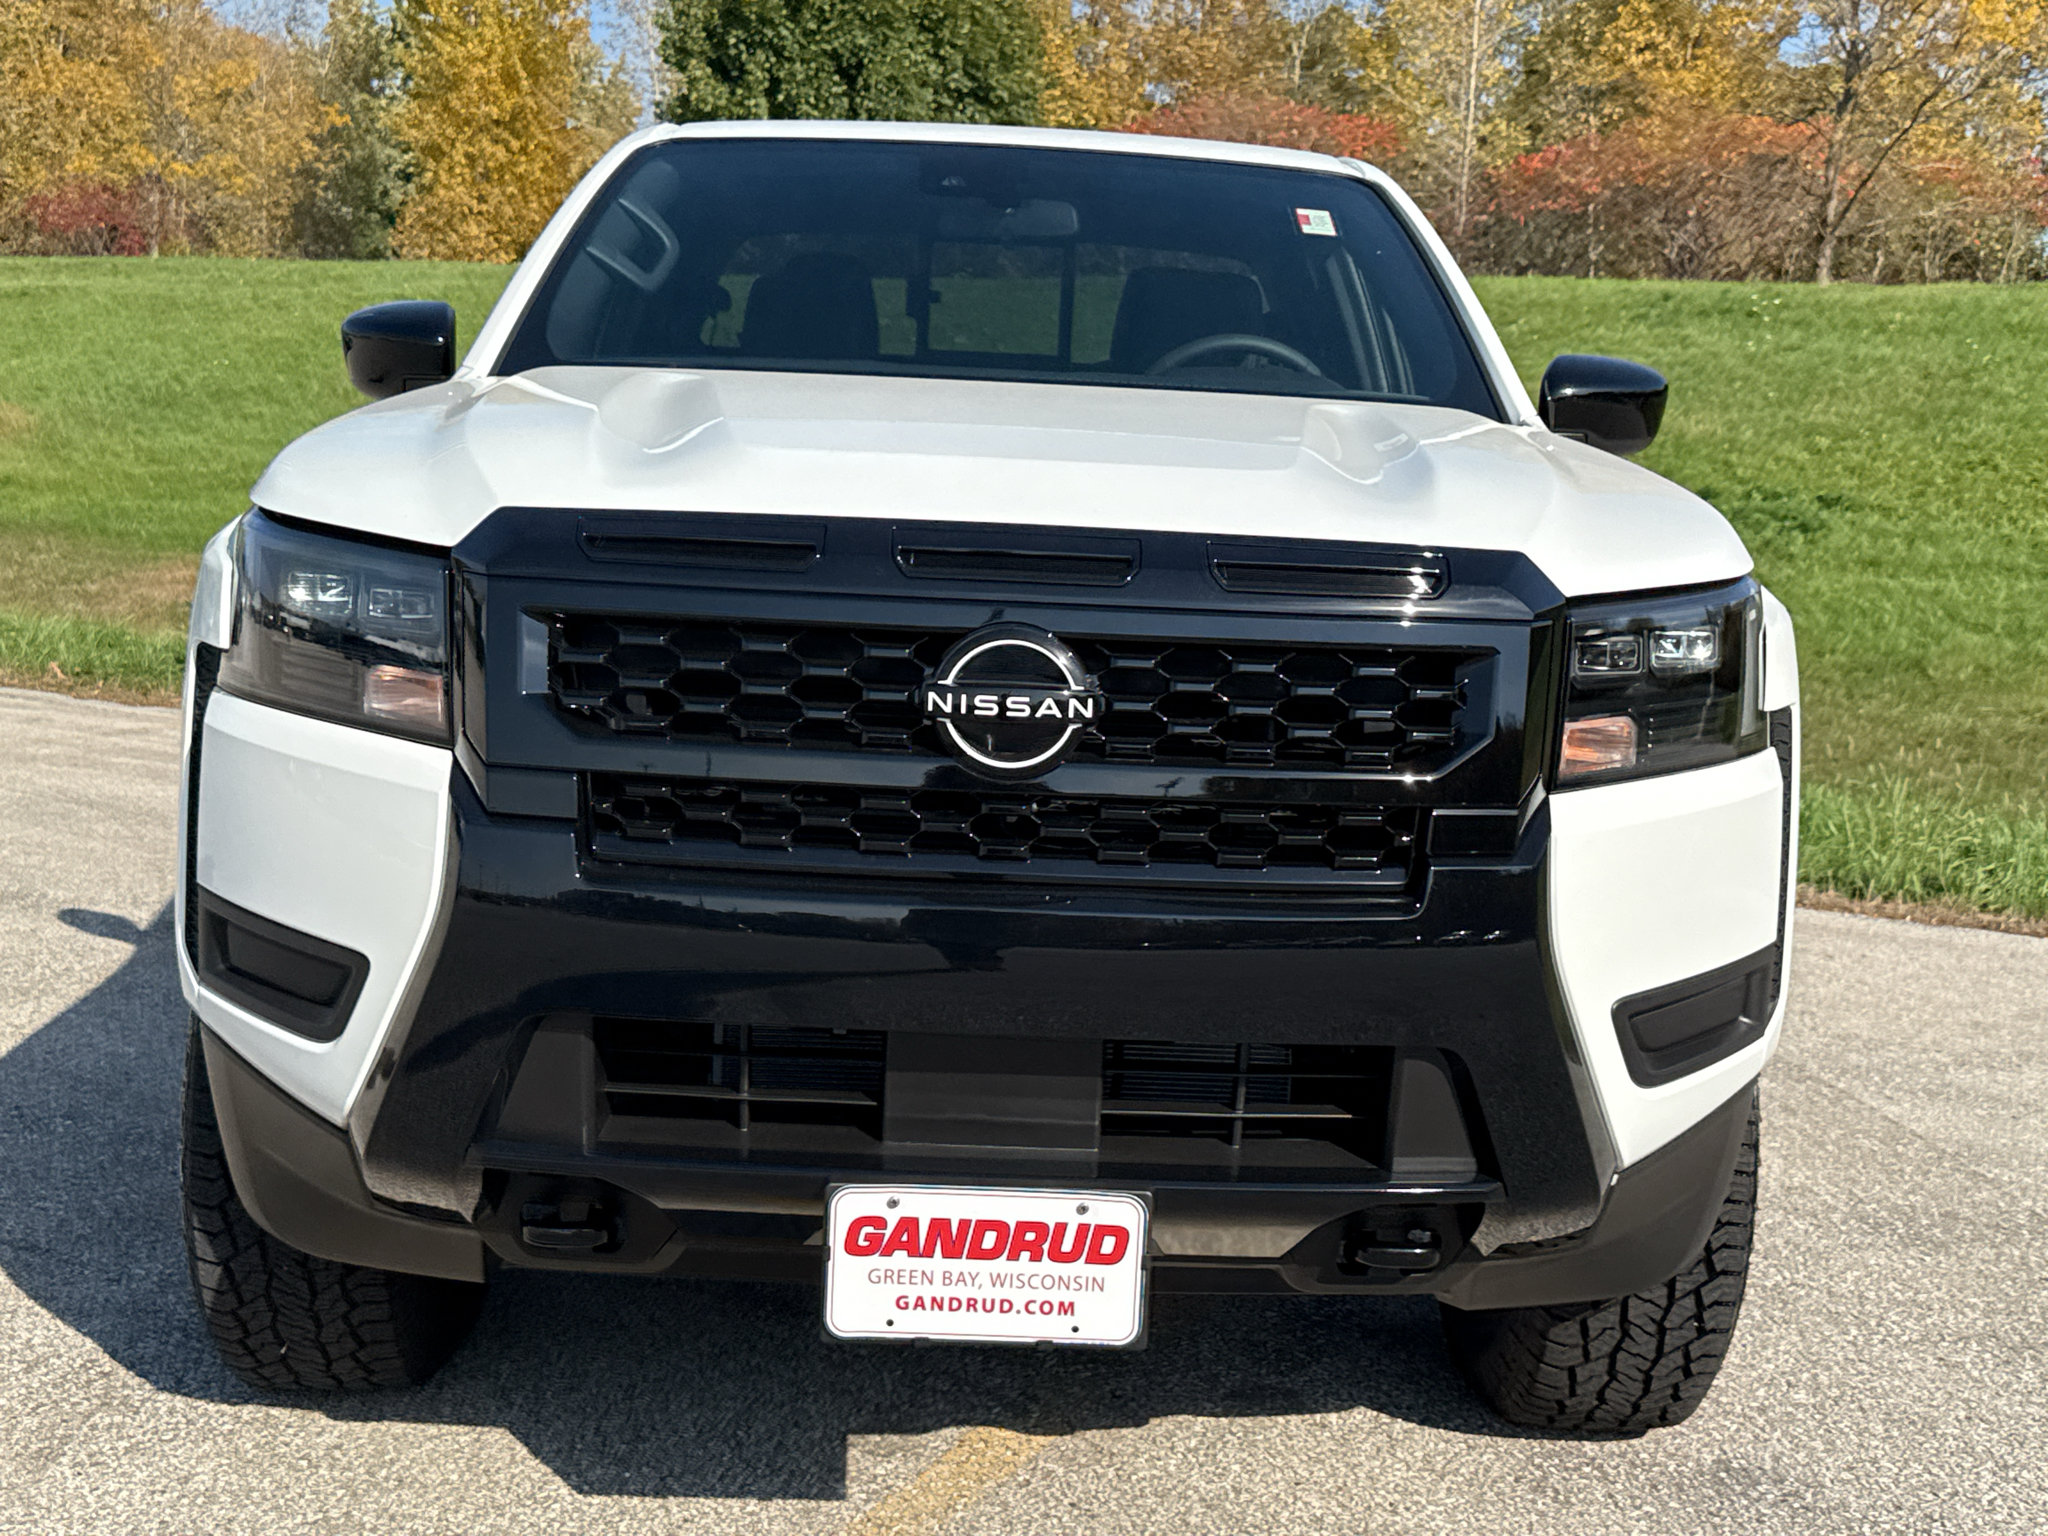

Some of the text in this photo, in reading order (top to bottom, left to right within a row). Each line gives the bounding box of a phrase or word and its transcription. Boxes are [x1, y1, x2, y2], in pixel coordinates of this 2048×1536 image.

[927, 691, 1094, 719] NISSAN
[843, 1215, 1130, 1266] GANDRUD
[867, 1268, 1106, 1293] GREEN BAY, WISCONSIN
[895, 1295, 1076, 1316] GANDRUD.COM
